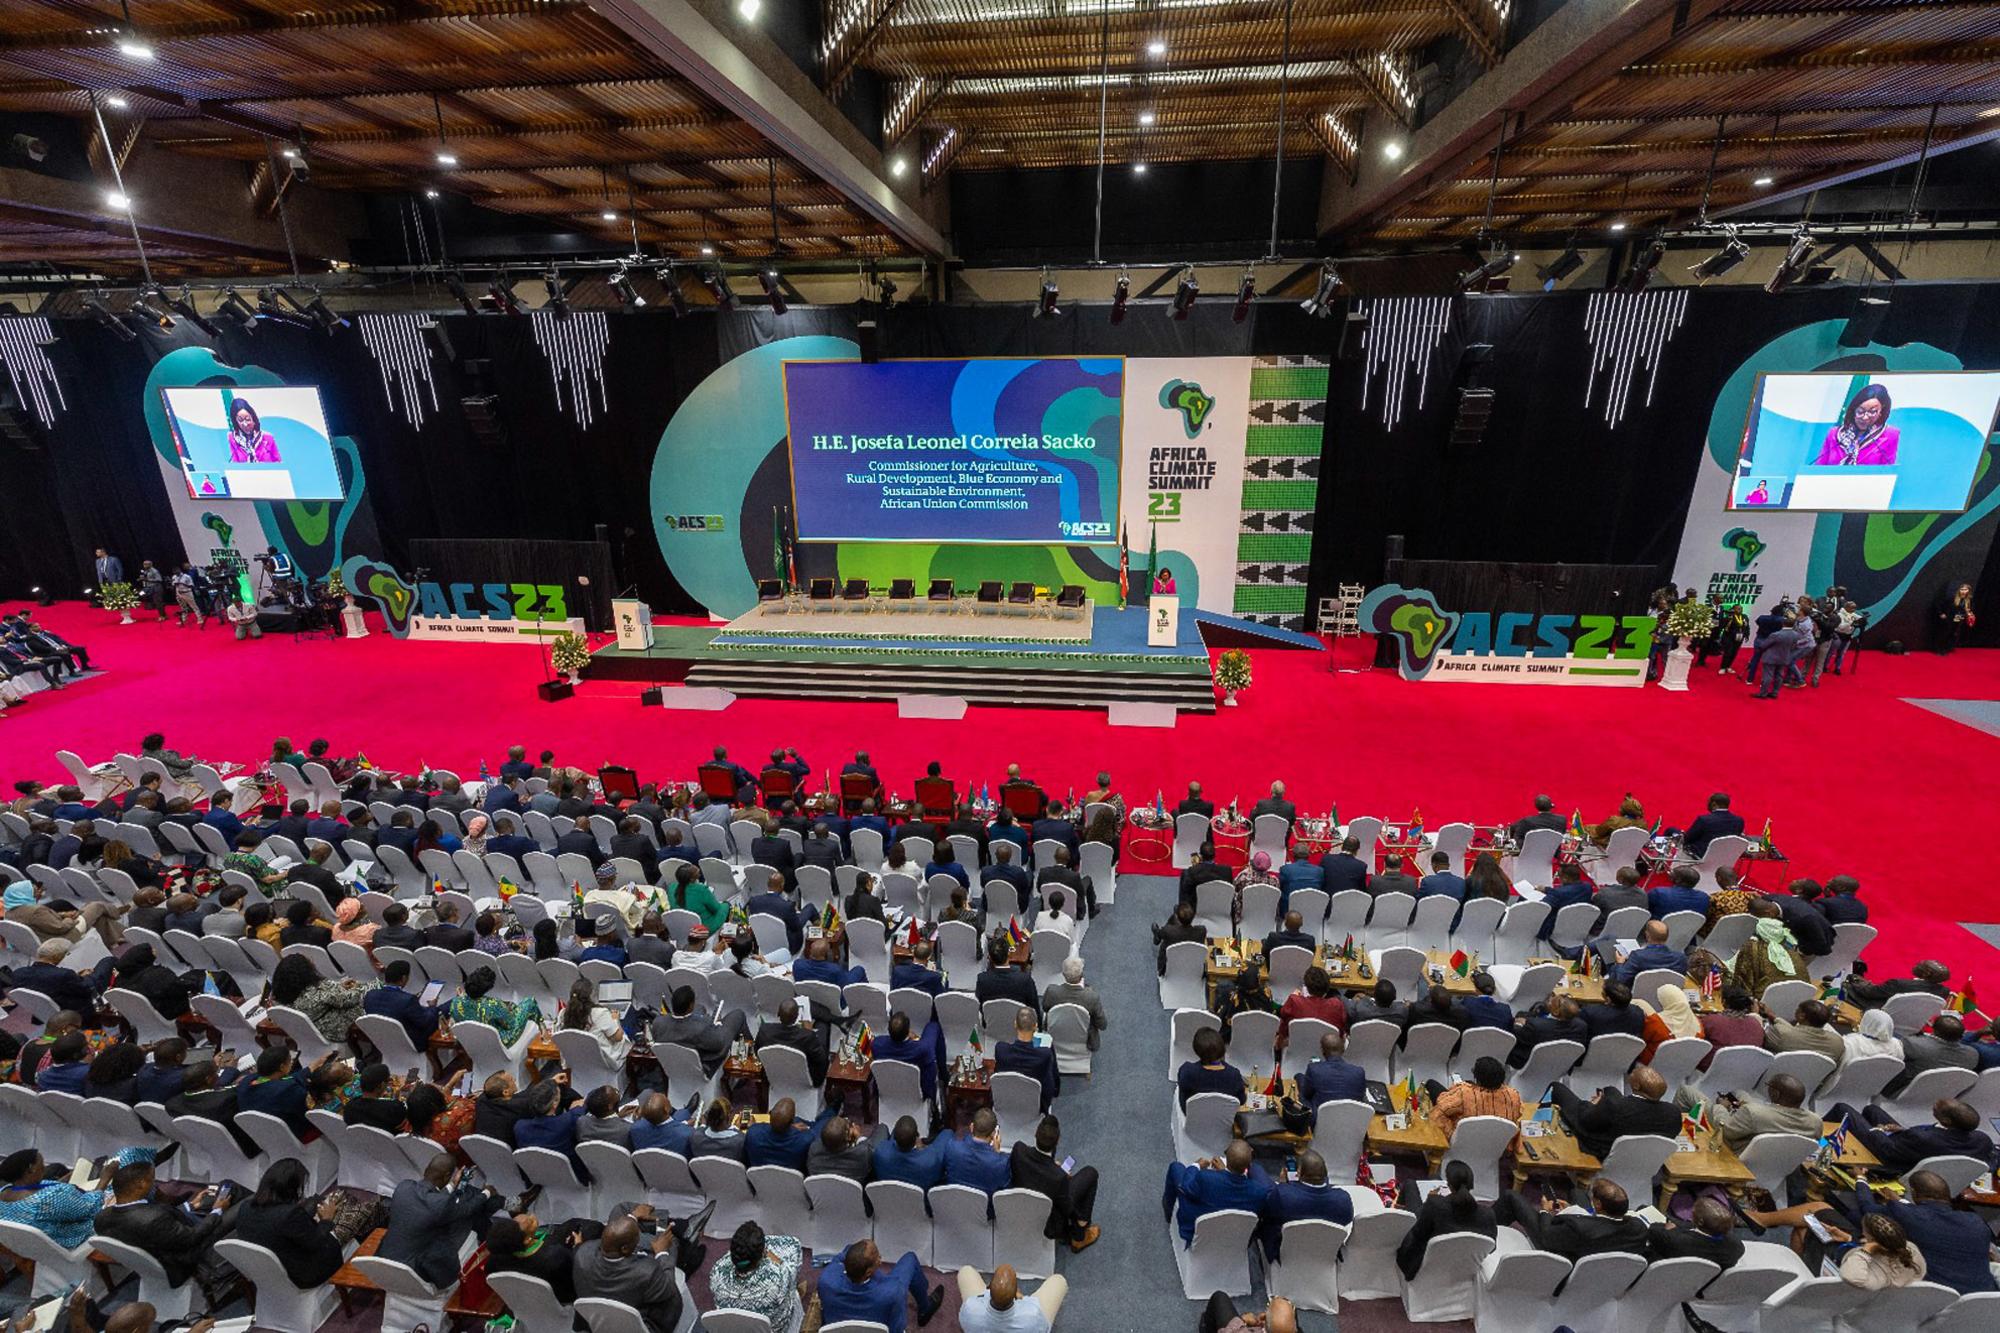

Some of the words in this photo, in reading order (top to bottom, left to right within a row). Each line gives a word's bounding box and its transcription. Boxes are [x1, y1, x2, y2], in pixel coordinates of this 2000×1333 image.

[812, 435, 849, 450] H.E.
[851, 434, 905, 454] Josefa
[906, 434, 968, 450] Leonel
[970, 433, 1040, 450] Correia
[1041, 433, 1096, 450] Sacko
[1149, 447, 1207, 461] AFRICA
[868, 461, 949, 472] Commissioner
[951, 460, 968, 472] for
[969, 461, 1039, 474] Agriculture,
[1149, 461, 1217, 475] CLIMATE
[846, 473, 876, 484] Rural
[878, 473, 957, 486] Development,
[958, 473, 984, 484] Blue
[986, 473, 1040, 486] Economy
[1040, 473, 1064, 484] and
[1148, 476, 1213, 490] SUMMIT
[882, 486, 947, 496] Sustainable
[948, 486, 1026, 498] Environment,
[880, 498, 921, 509] African
[923, 499, 957, 509] Union
[959, 499, 1029, 510] Commission
[1148, 492, 1182, 516] 23
[1710, 572, 1757, 583] AFRICA
[1707, 583, 1764, 594] CLIMATE
[419, 582, 568, 622] ACS23
[1705, 593, 1759, 604] SMMIT
[1451, 612, 1657, 660] ACS23
[1444, 663, 1476, 672] AFRICA
[1481, 663, 1521, 673] CLIMATE
[1526, 664, 1565, 674] SUMMIT
